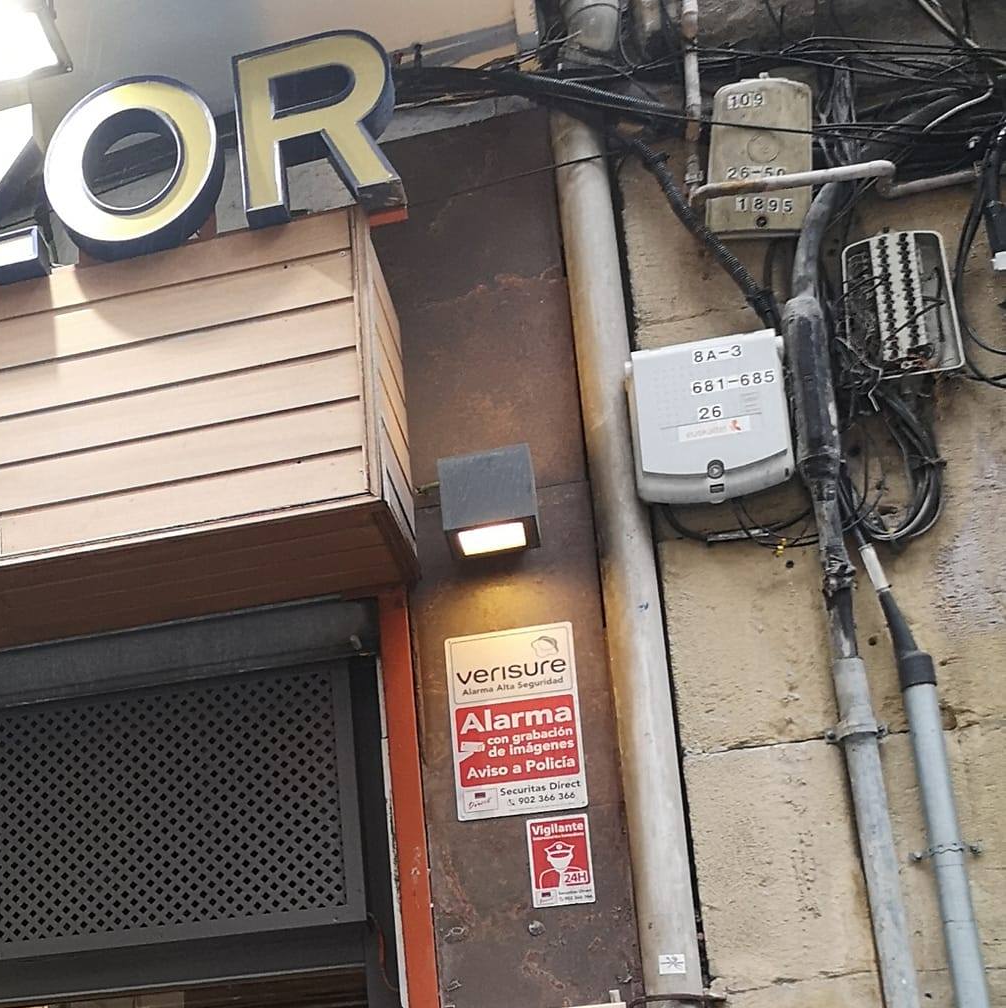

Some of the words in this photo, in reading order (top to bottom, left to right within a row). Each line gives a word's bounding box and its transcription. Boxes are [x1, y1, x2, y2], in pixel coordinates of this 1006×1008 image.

[736, 197, 793, 213] 1895
[693, 344, 742, 363] 8A-3
[692, 370, 775, 394] 681-685
[698, 405, 722, 420] 26
[456, 658, 566, 685] verisure
[462, 686, 494, 696] Alarma
[496, 683, 515, 692] Alta
[517, 676, 564, 690] Seguridad
[460, 705, 572, 735] Alarma
[487, 735, 509, 745] con
[512, 726, 573, 745] grabación
[488, 746, 506, 757] de
[509, 739, 575, 756] imágenes
[466, 764, 509, 780] Aviso
[512, 764, 522, 774] a
[526, 755, 575, 773] Policía
[500, 784, 547, 796] Securitas
[549, 779, 581, 791] Direct
[518, 796, 536, 805] 902
[538, 794, 556, 803] 366
[558, 791, 576, 801] 366
[531, 822, 584, 837] Vigilante
[564, 872, 587, 884] 24H
